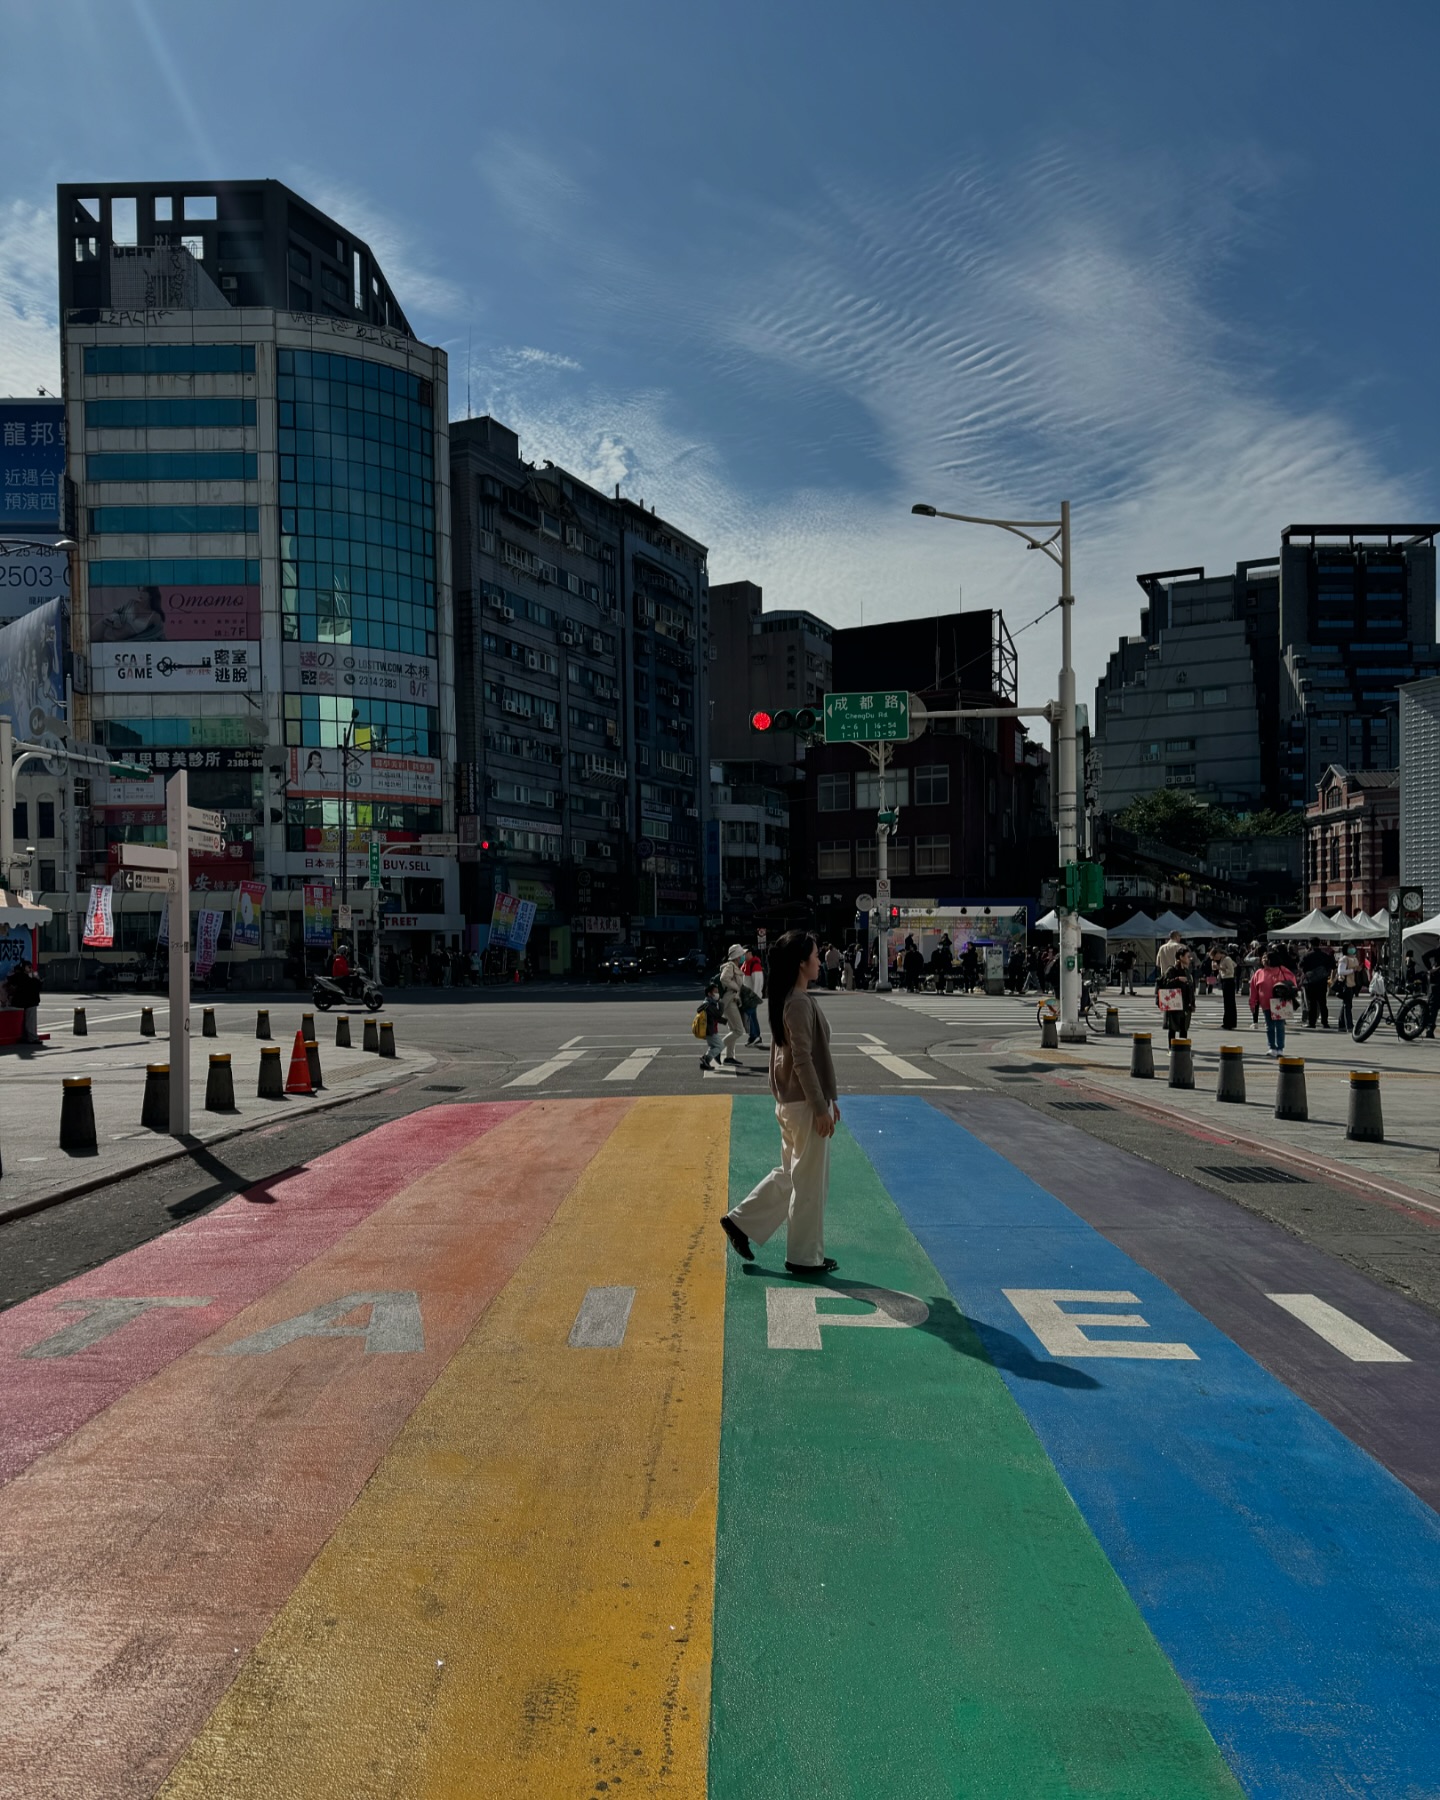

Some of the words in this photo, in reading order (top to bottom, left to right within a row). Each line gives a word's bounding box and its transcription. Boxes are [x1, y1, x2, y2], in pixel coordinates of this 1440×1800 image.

[5, 468, 64, 487] 近遇台
[5, 492, 57, 511] 預演西
[168, 593, 244, 614] Qmomo
[214, 649, 247, 665] 密室
[118, 667, 153, 679] GAME
[358, 659, 402, 673] LOSTTW.COM
[834, 694, 899, 711] 成都路
[845, 712, 875, 721] ChengDu
[234, 751, 264, 759] DrPlu
[384, 917, 418, 926] TREET
